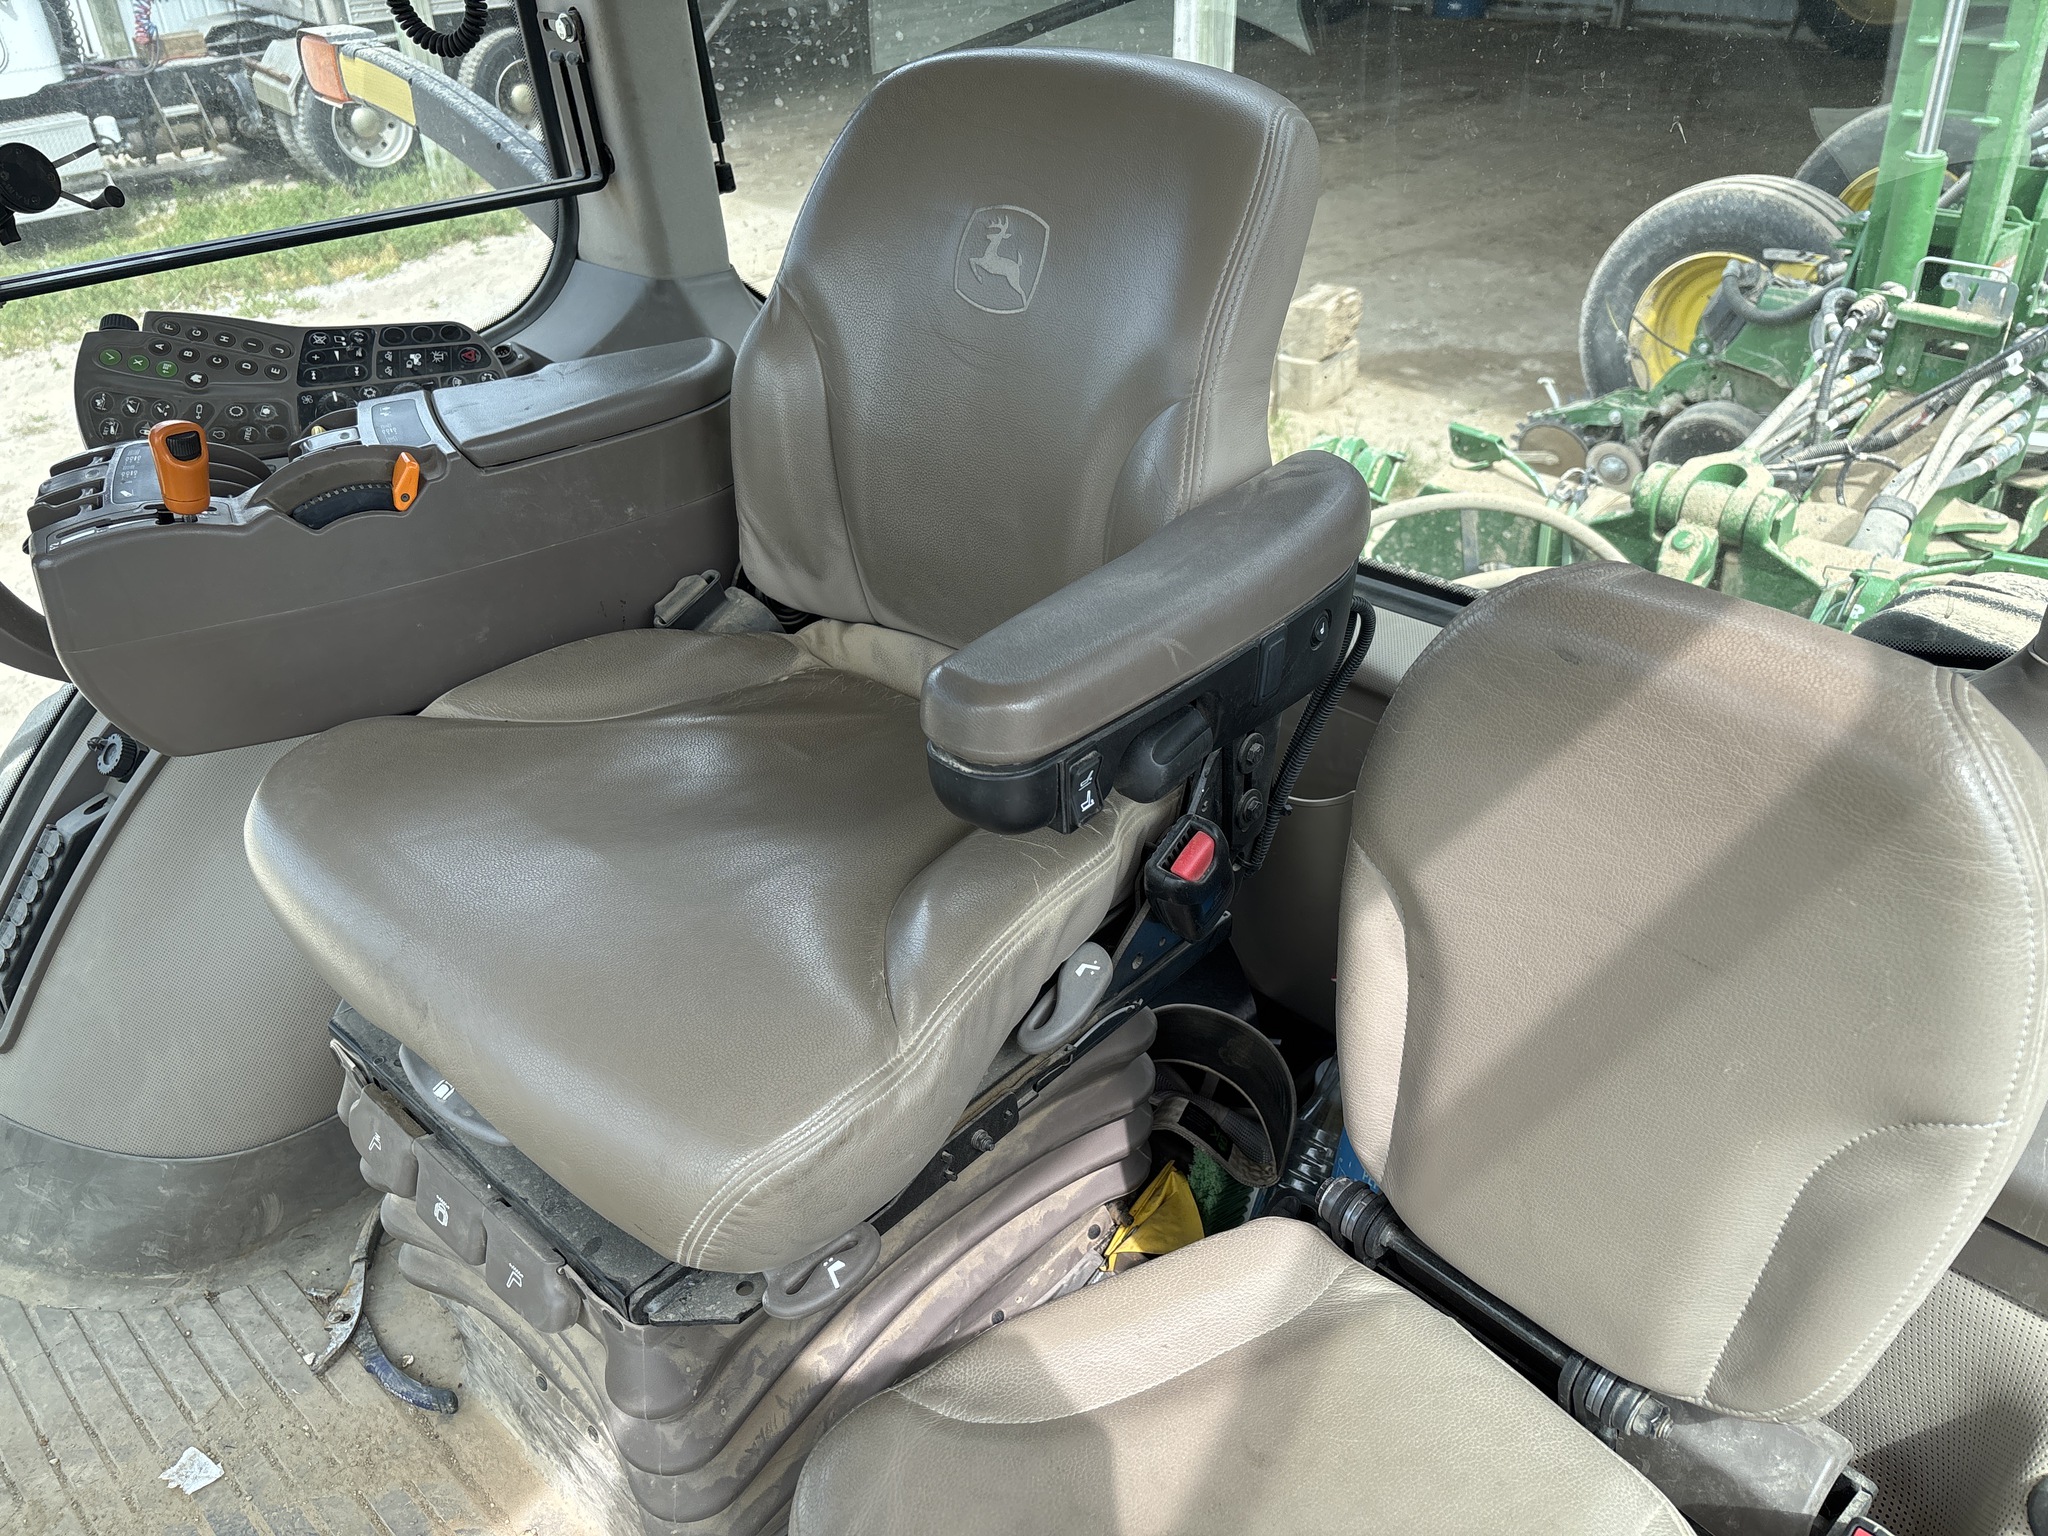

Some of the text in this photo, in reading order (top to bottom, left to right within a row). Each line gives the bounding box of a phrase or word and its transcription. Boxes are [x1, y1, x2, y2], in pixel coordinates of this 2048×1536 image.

[164, 323, 174, 331] F
[191, 329, 201, 337] G
[219, 335, 229, 343] H
[241, 362, 251, 370] D
[270, 367, 281, 375] E
